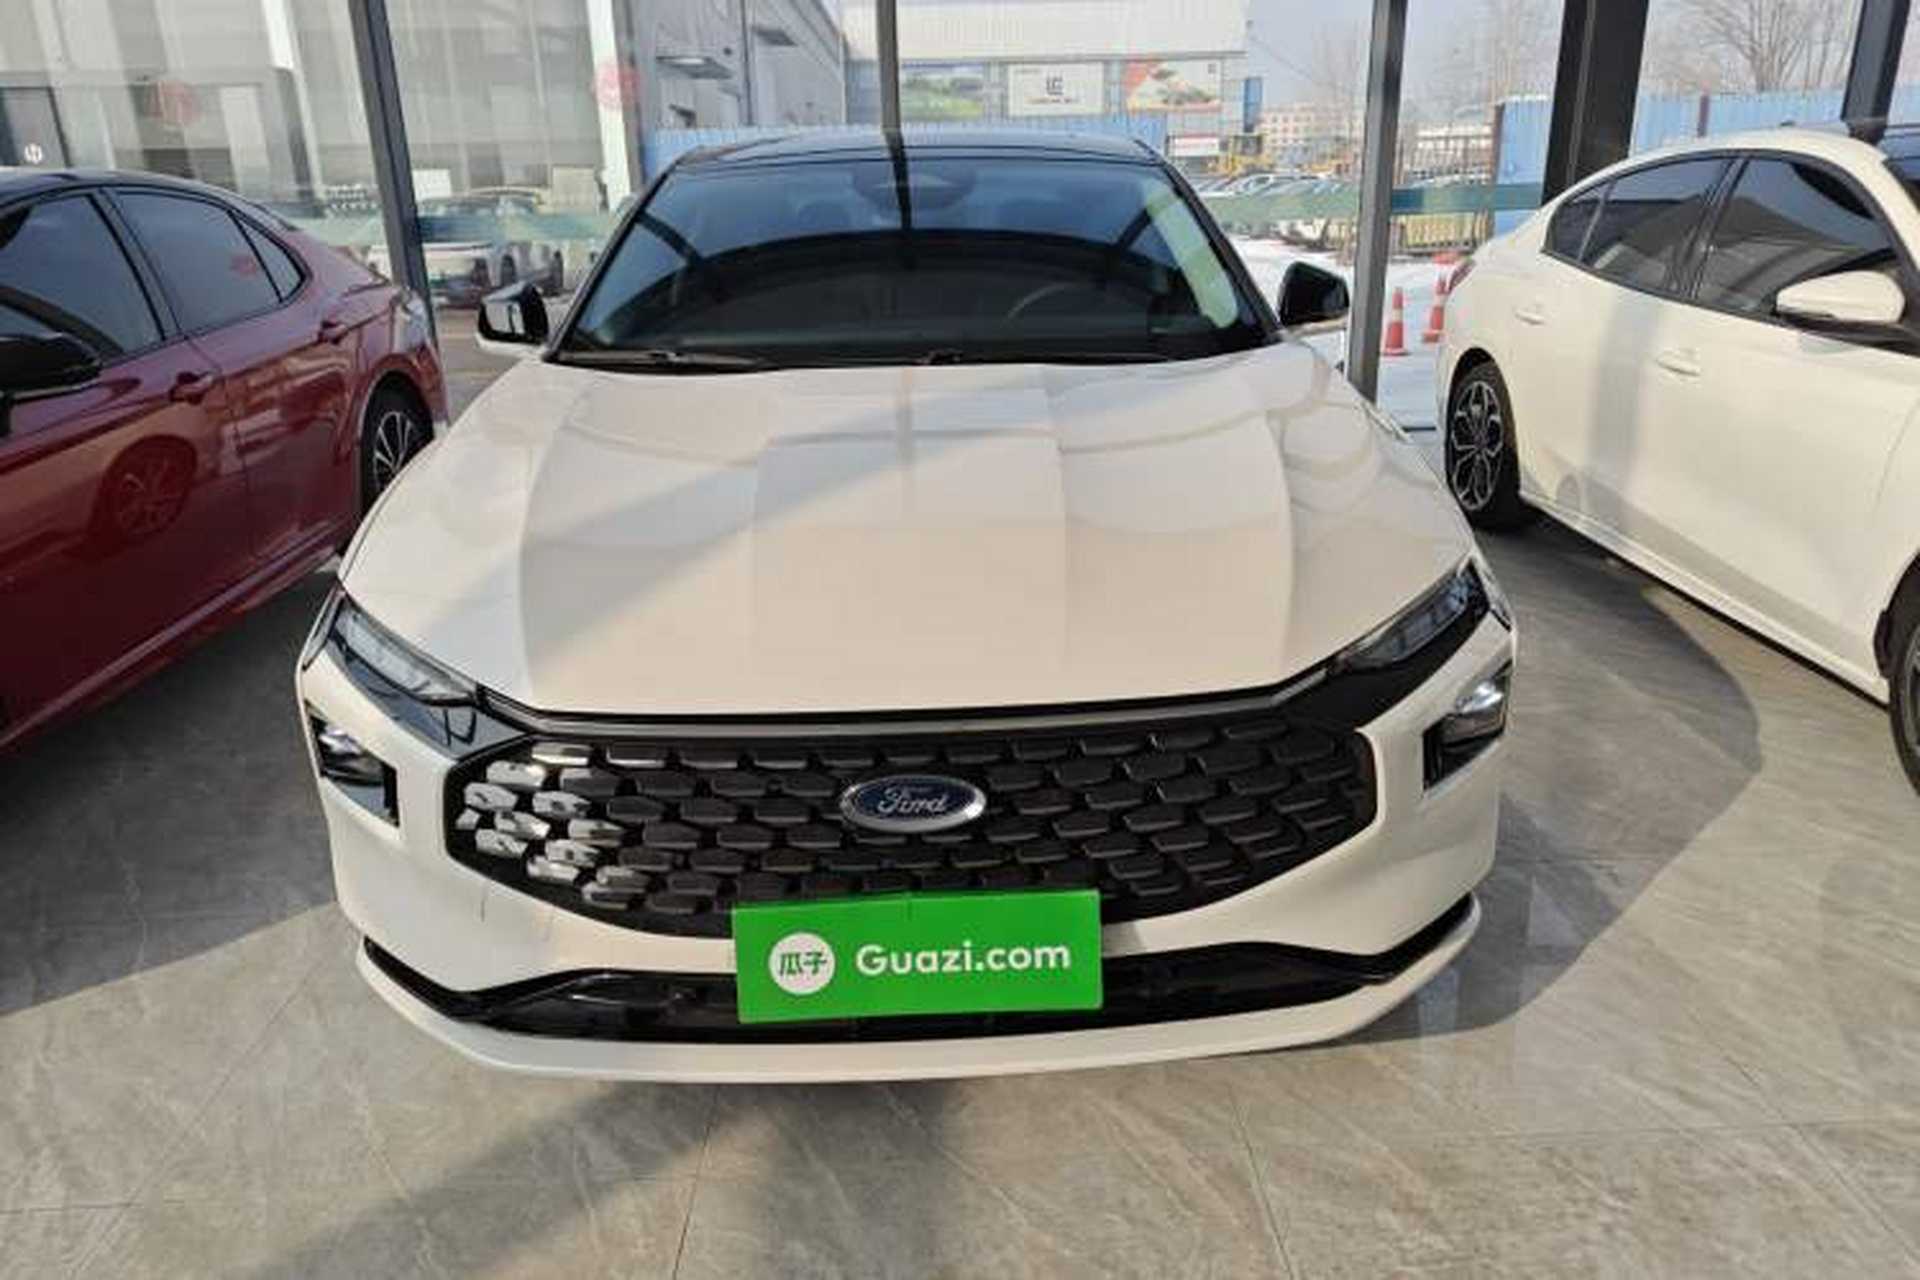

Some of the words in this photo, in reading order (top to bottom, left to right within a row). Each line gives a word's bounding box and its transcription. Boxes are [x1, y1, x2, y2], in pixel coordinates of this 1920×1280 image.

[876, 786, 950, 815] Ford
[779, 950, 828, 977] 瓜子
[856, 941, 1070, 977] Guazi.com
